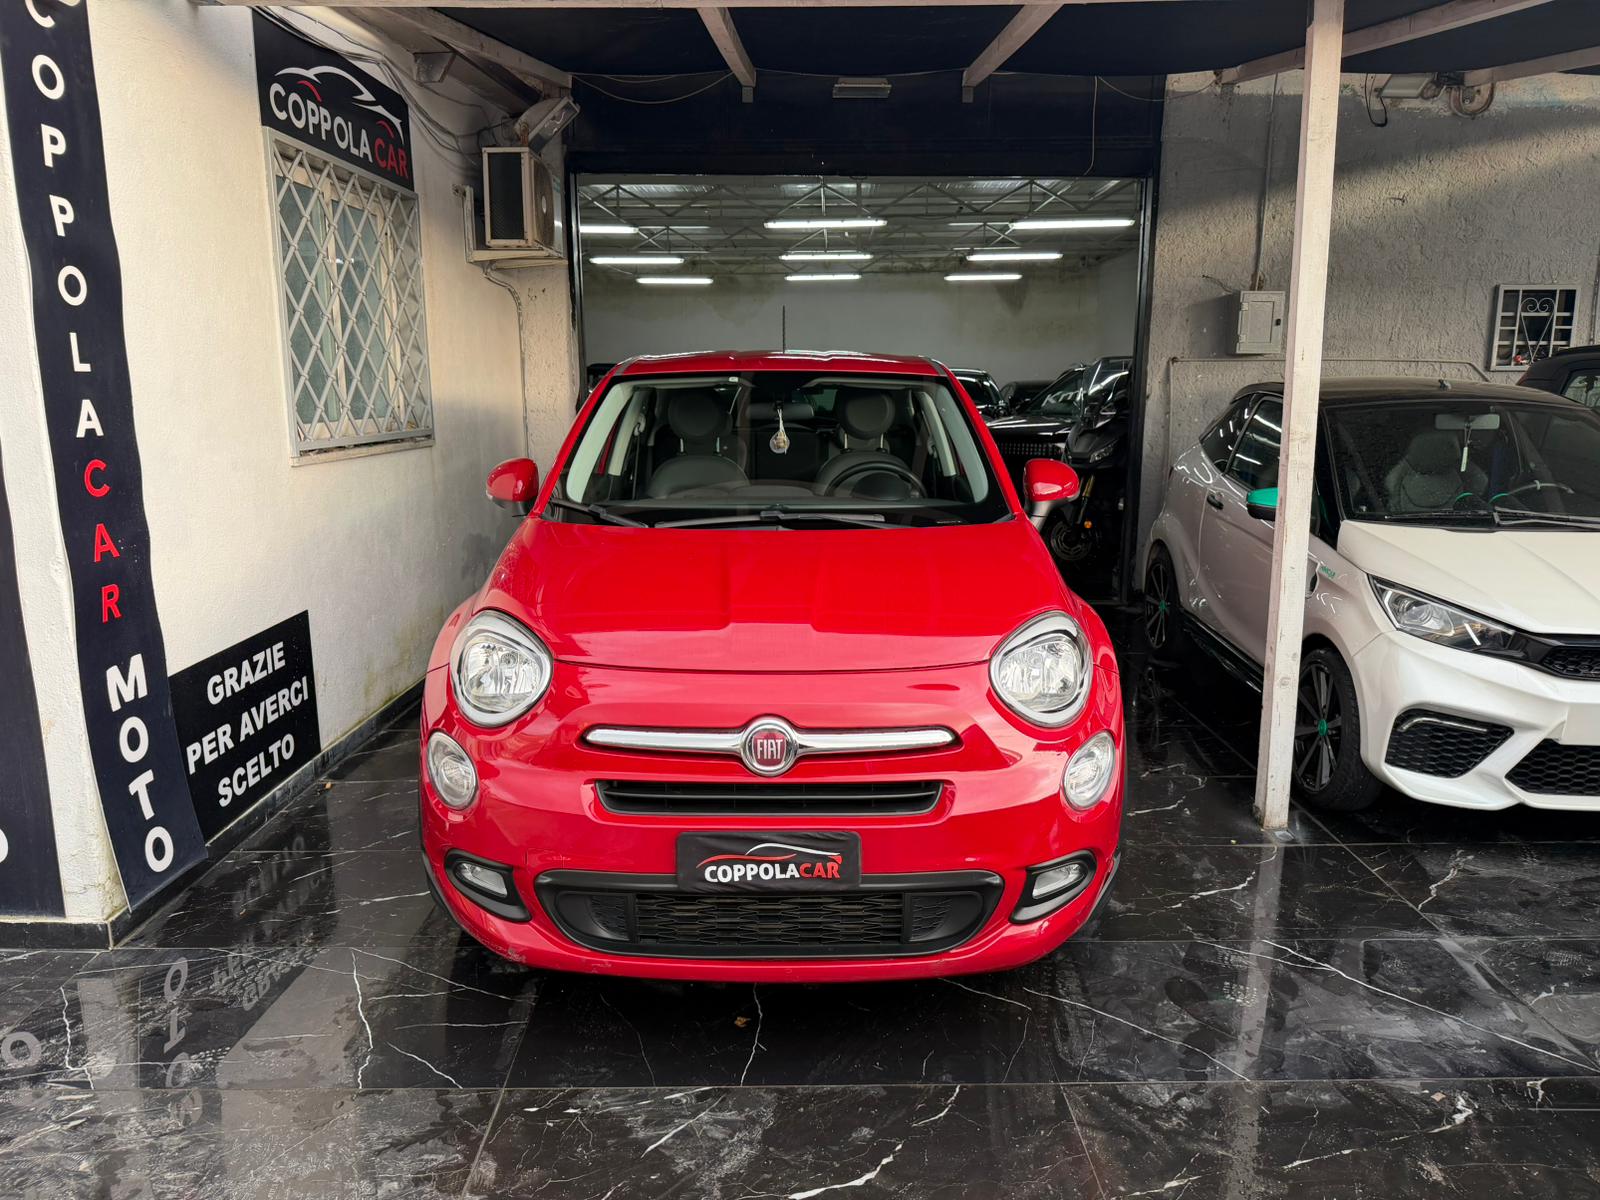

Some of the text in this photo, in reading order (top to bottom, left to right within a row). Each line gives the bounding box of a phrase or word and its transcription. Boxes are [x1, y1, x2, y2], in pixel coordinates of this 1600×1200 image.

[207, 641, 286, 705] GRAZIE
[106, 653, 174, 873] MOTO
[186, 676, 309, 776] PER AVERCI
[757, 739, 784, 759] FIAT
[217, 733, 295, 808] SCELTO
